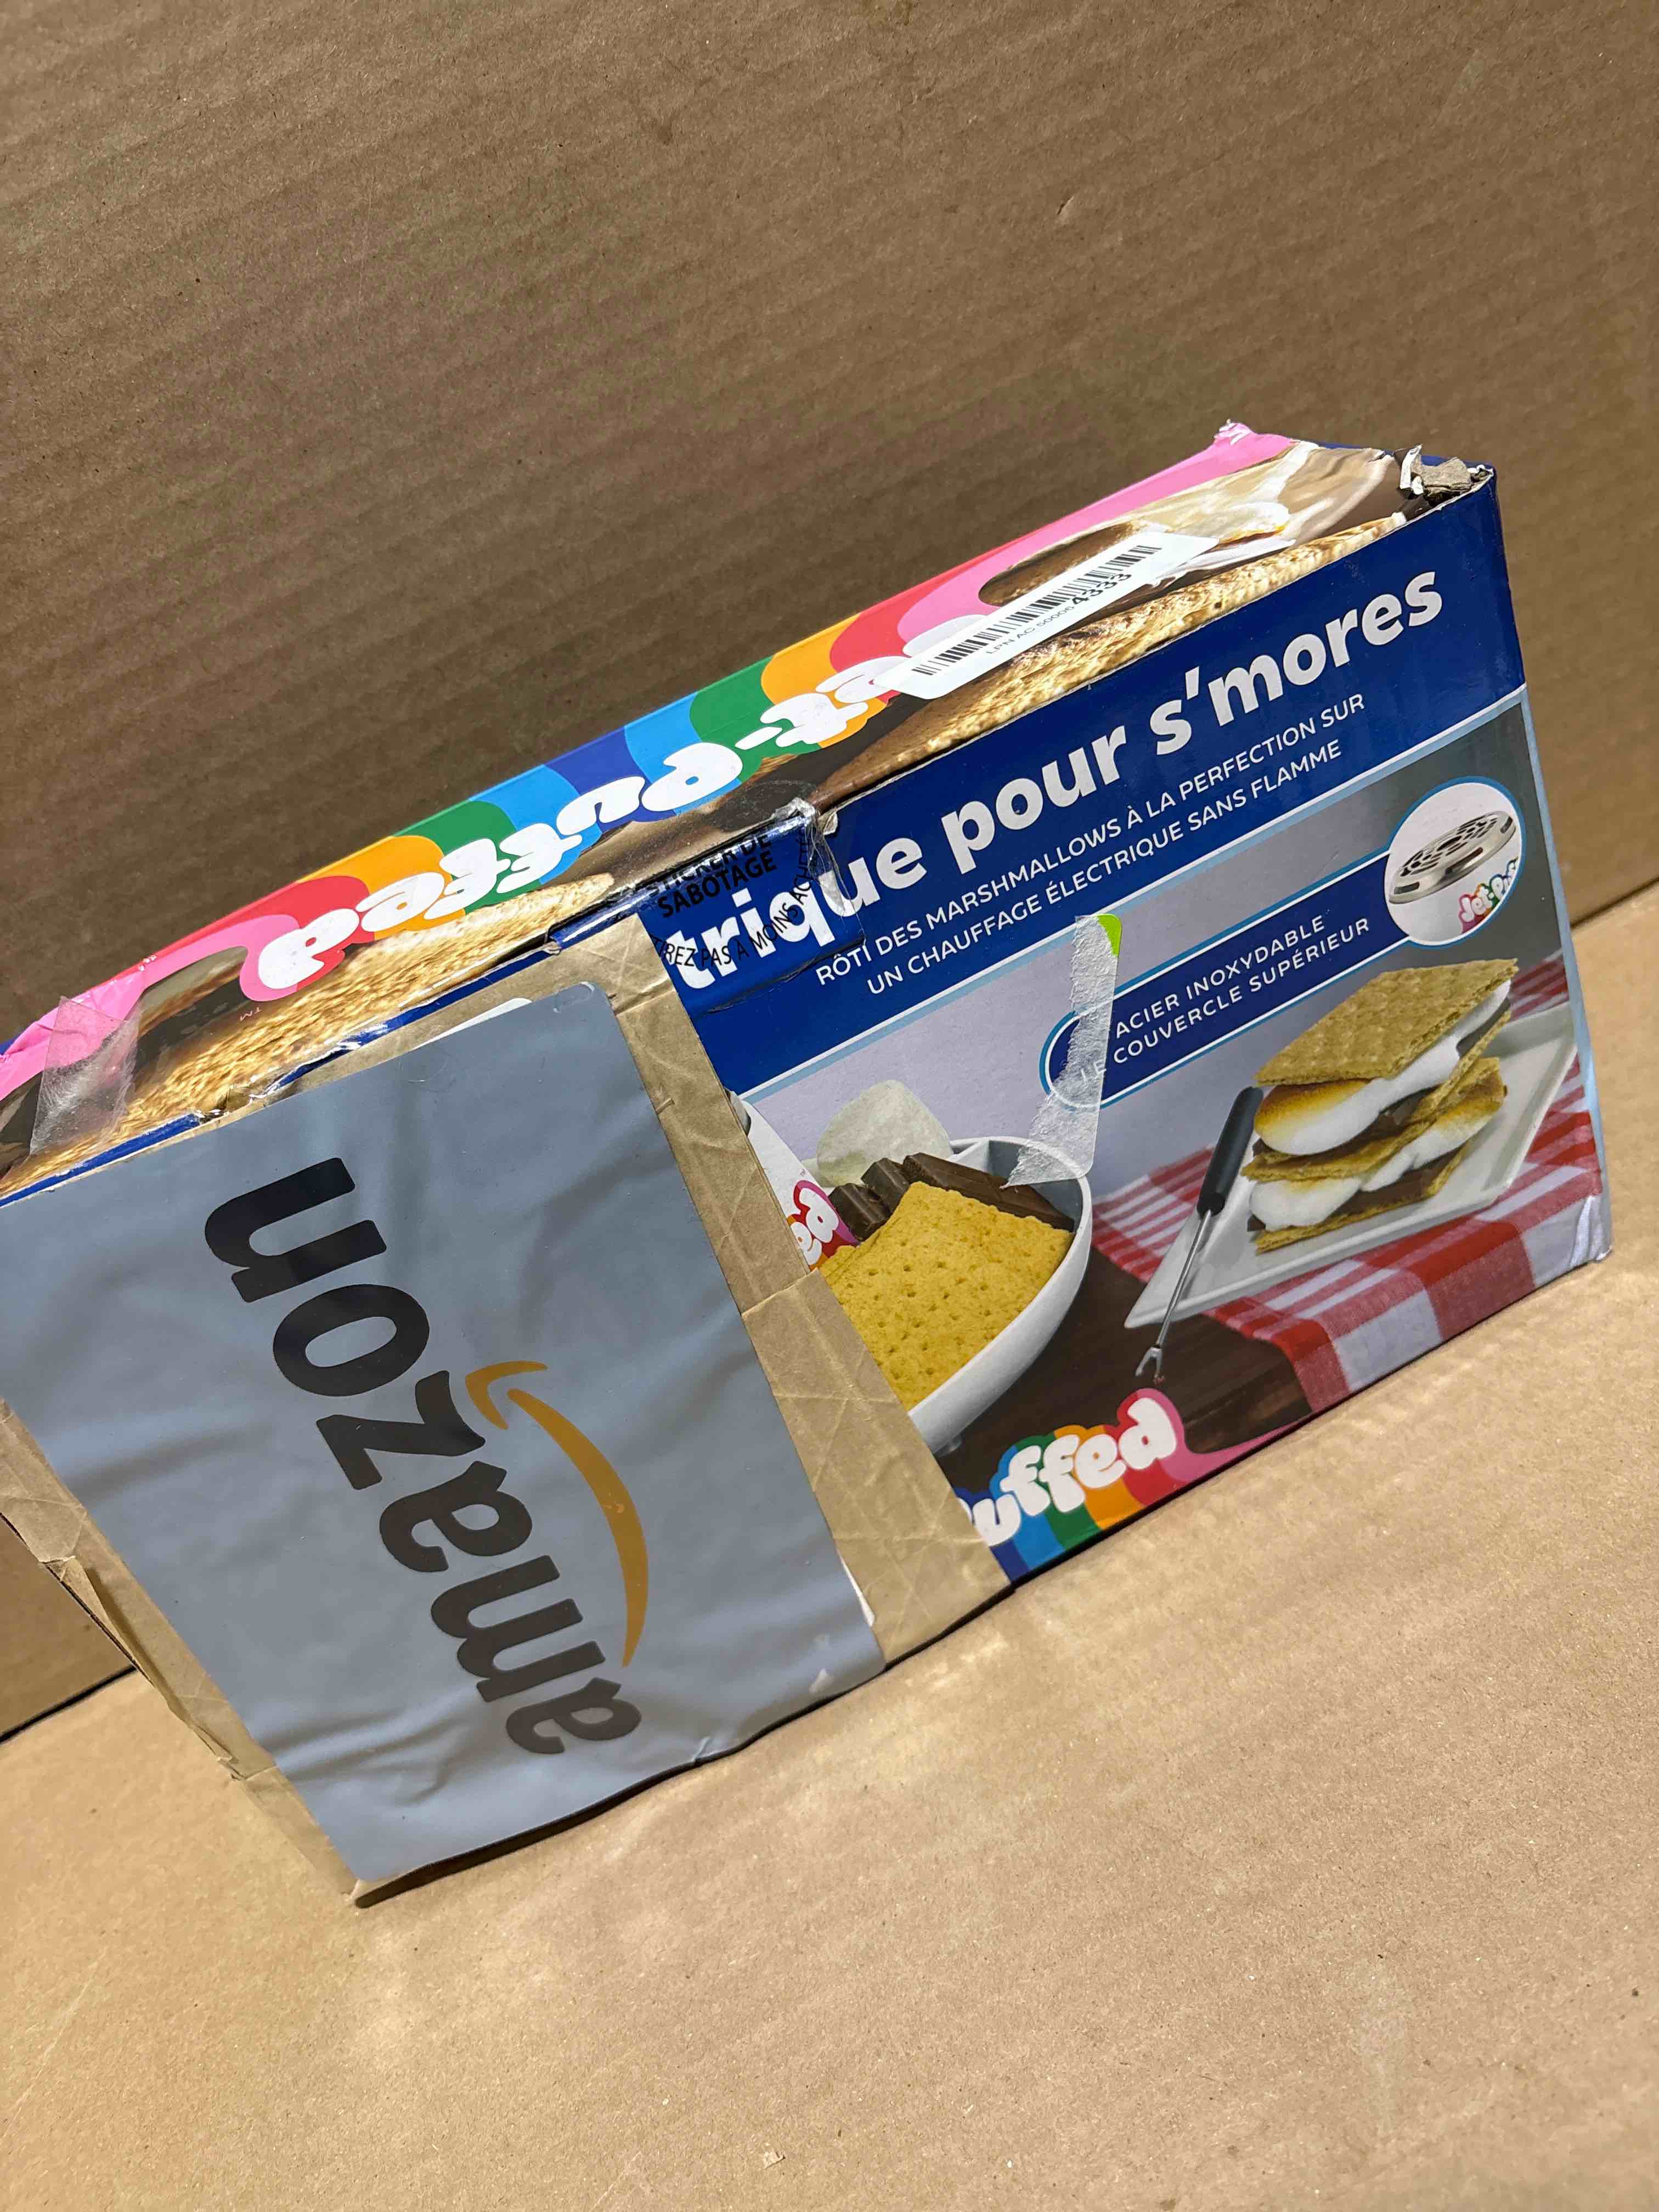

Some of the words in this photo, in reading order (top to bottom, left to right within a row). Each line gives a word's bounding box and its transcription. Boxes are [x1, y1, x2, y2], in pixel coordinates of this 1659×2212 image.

[986, 639, 1015, 654] LPN
[665, 837, 928, 989] trique
[940, 725, 1127, 875] pour
[1149, 571, 1443, 755] s'mores
[816, 945, 872, 985] RÔTI
[875, 920, 922, 956] DES
[926, 819, 1121, 930] MARSHMALLOWS
[1127, 806, 1143, 829] À
[1146, 792, 1176, 817] LA
[1179, 718, 1316, 801] PERFECTION
[1321, 693, 1365, 727] SUR
[658, 850, 777, 918] SABOTAGE
[701, 945, 732, 966] PAS
[749, 902, 798, 951] MOINS
[867, 966, 904, 994] UN
[908, 894, 1042, 974] CHAUFFAGE
[1045, 821, 1184, 905] ÉLECTRIQUE
[1187, 789, 1246, 831] SANS
[1250, 739, 1342, 799] FLAMME
[1114, 985, 1243, 1063] COUVERCLE
[1249, 918, 1369, 992] SUPÉRIEUR
[1116, 994, 1180, 1039] ACIER
[1186, 915, 1325, 1000] INOXYDABLE
[204, 1157, 642, 1754] amazon
[958, 1397, 1177, 1547] uffed
